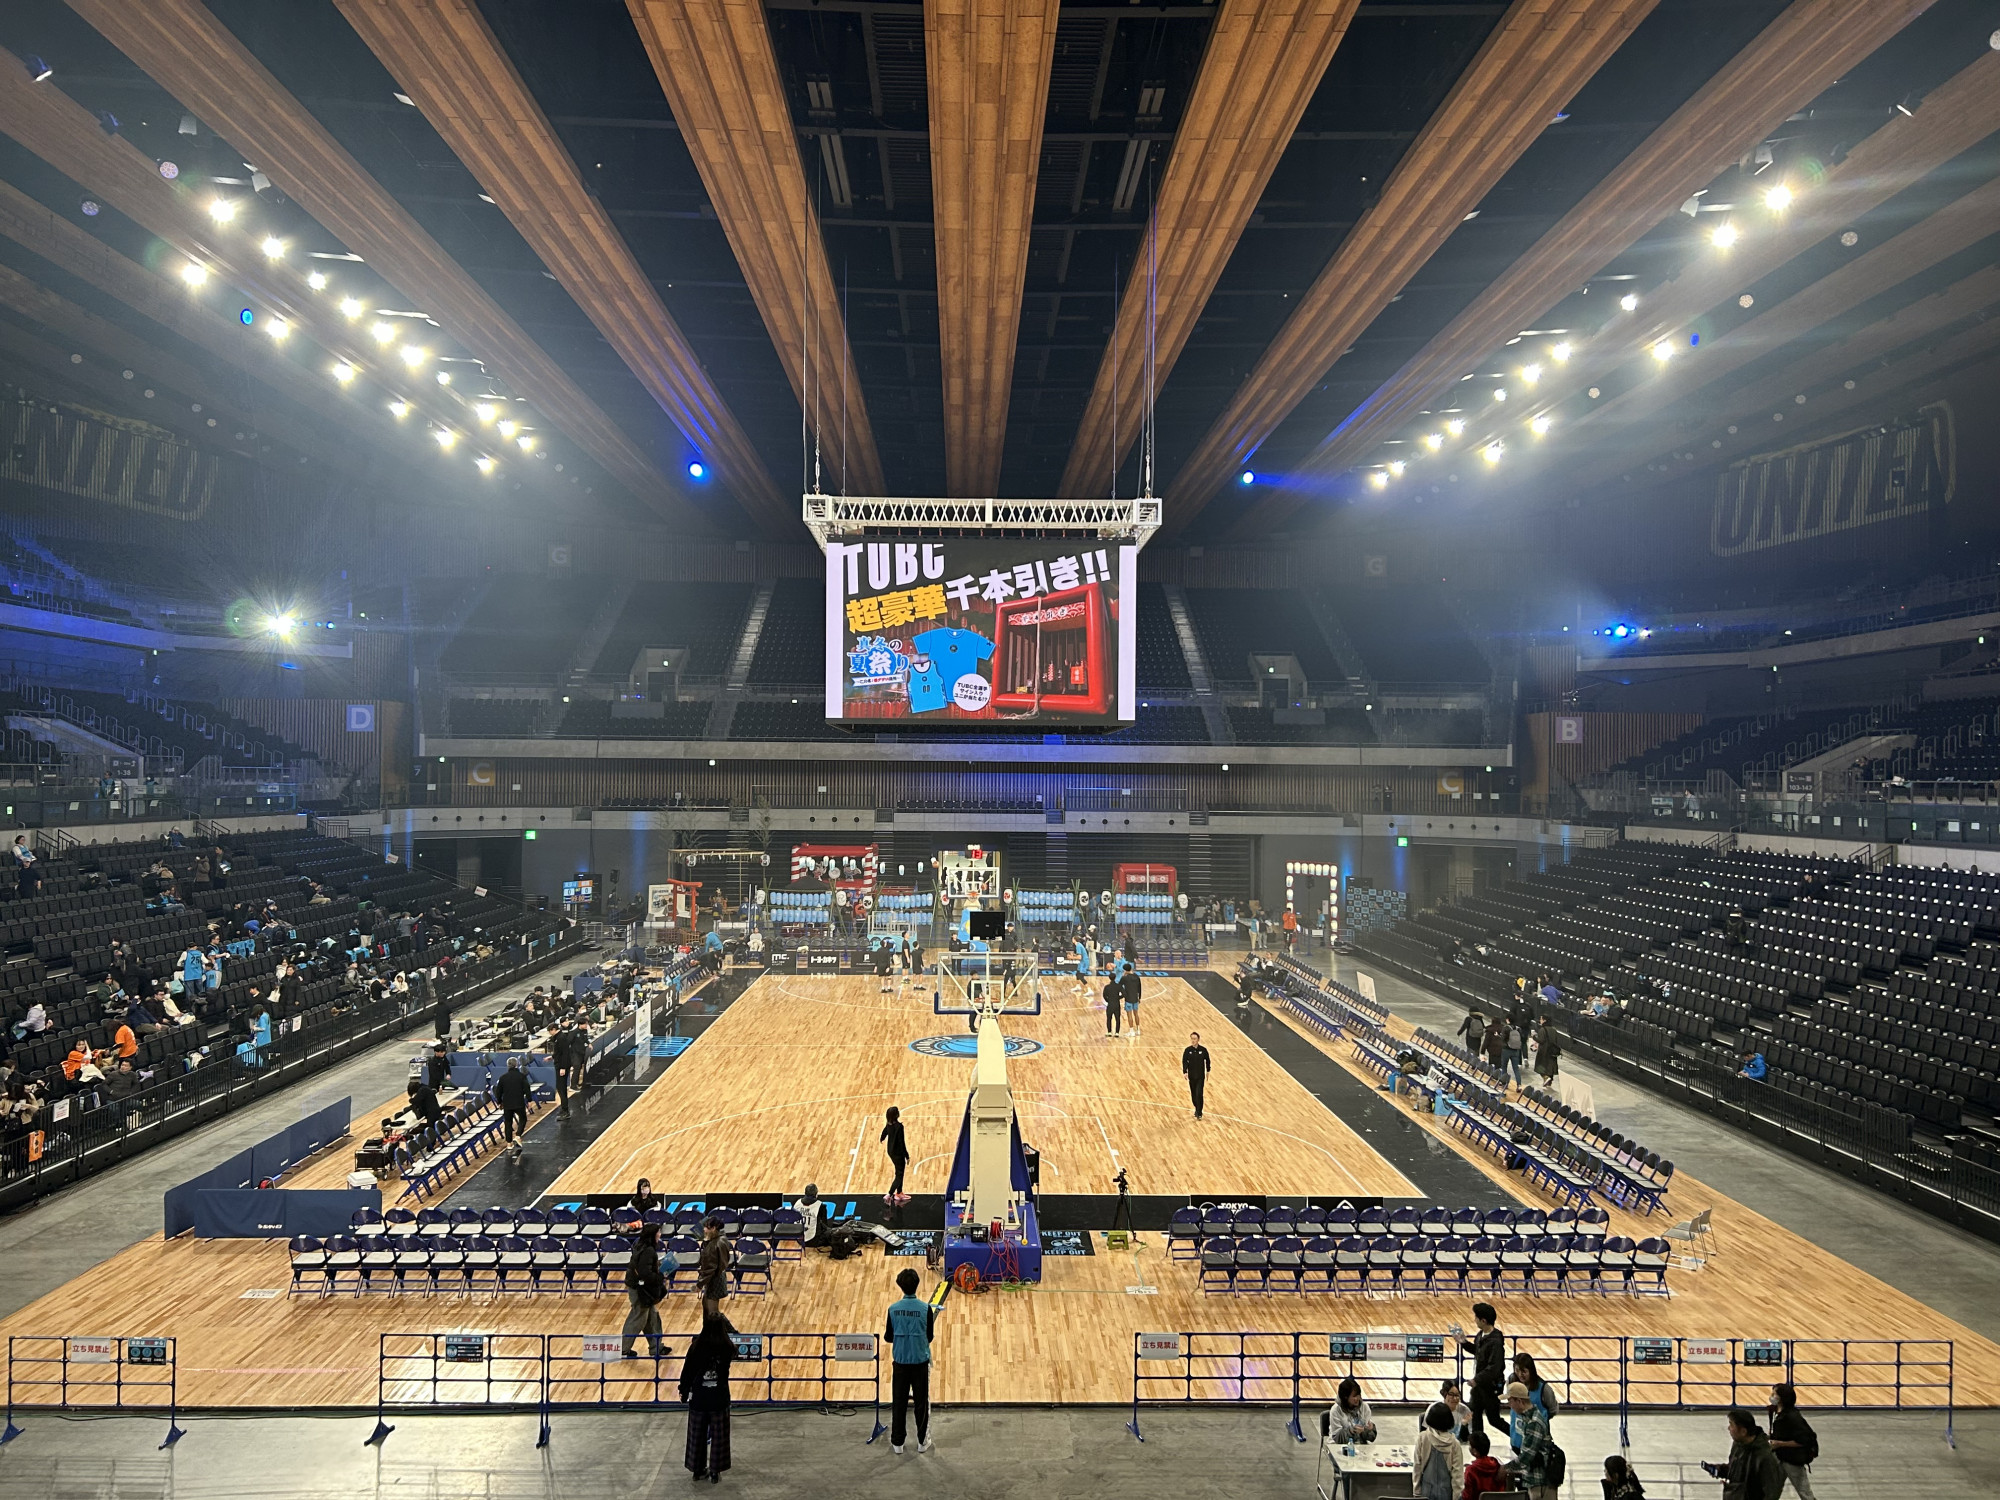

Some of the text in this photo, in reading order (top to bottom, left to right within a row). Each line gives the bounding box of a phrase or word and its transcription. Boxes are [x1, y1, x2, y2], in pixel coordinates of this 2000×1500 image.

[351, 707, 371, 729] D
[1561, 719, 1578, 741] B
[473, 762, 490, 784] C
[1442, 770, 1460, 792] C
[72, 1344, 110, 1354] 立ち見禁止
[583, 1343, 620, 1352] 立ち見禁止
[835, 1342, 873, 1351] 立ち見禁止
[1141, 1341, 1178, 1349] 立ち見禁止
[1368, 1342, 1405, 1351] 立ち見禁止
[1688, 1347, 1725, 1355] 立ち見禁止
